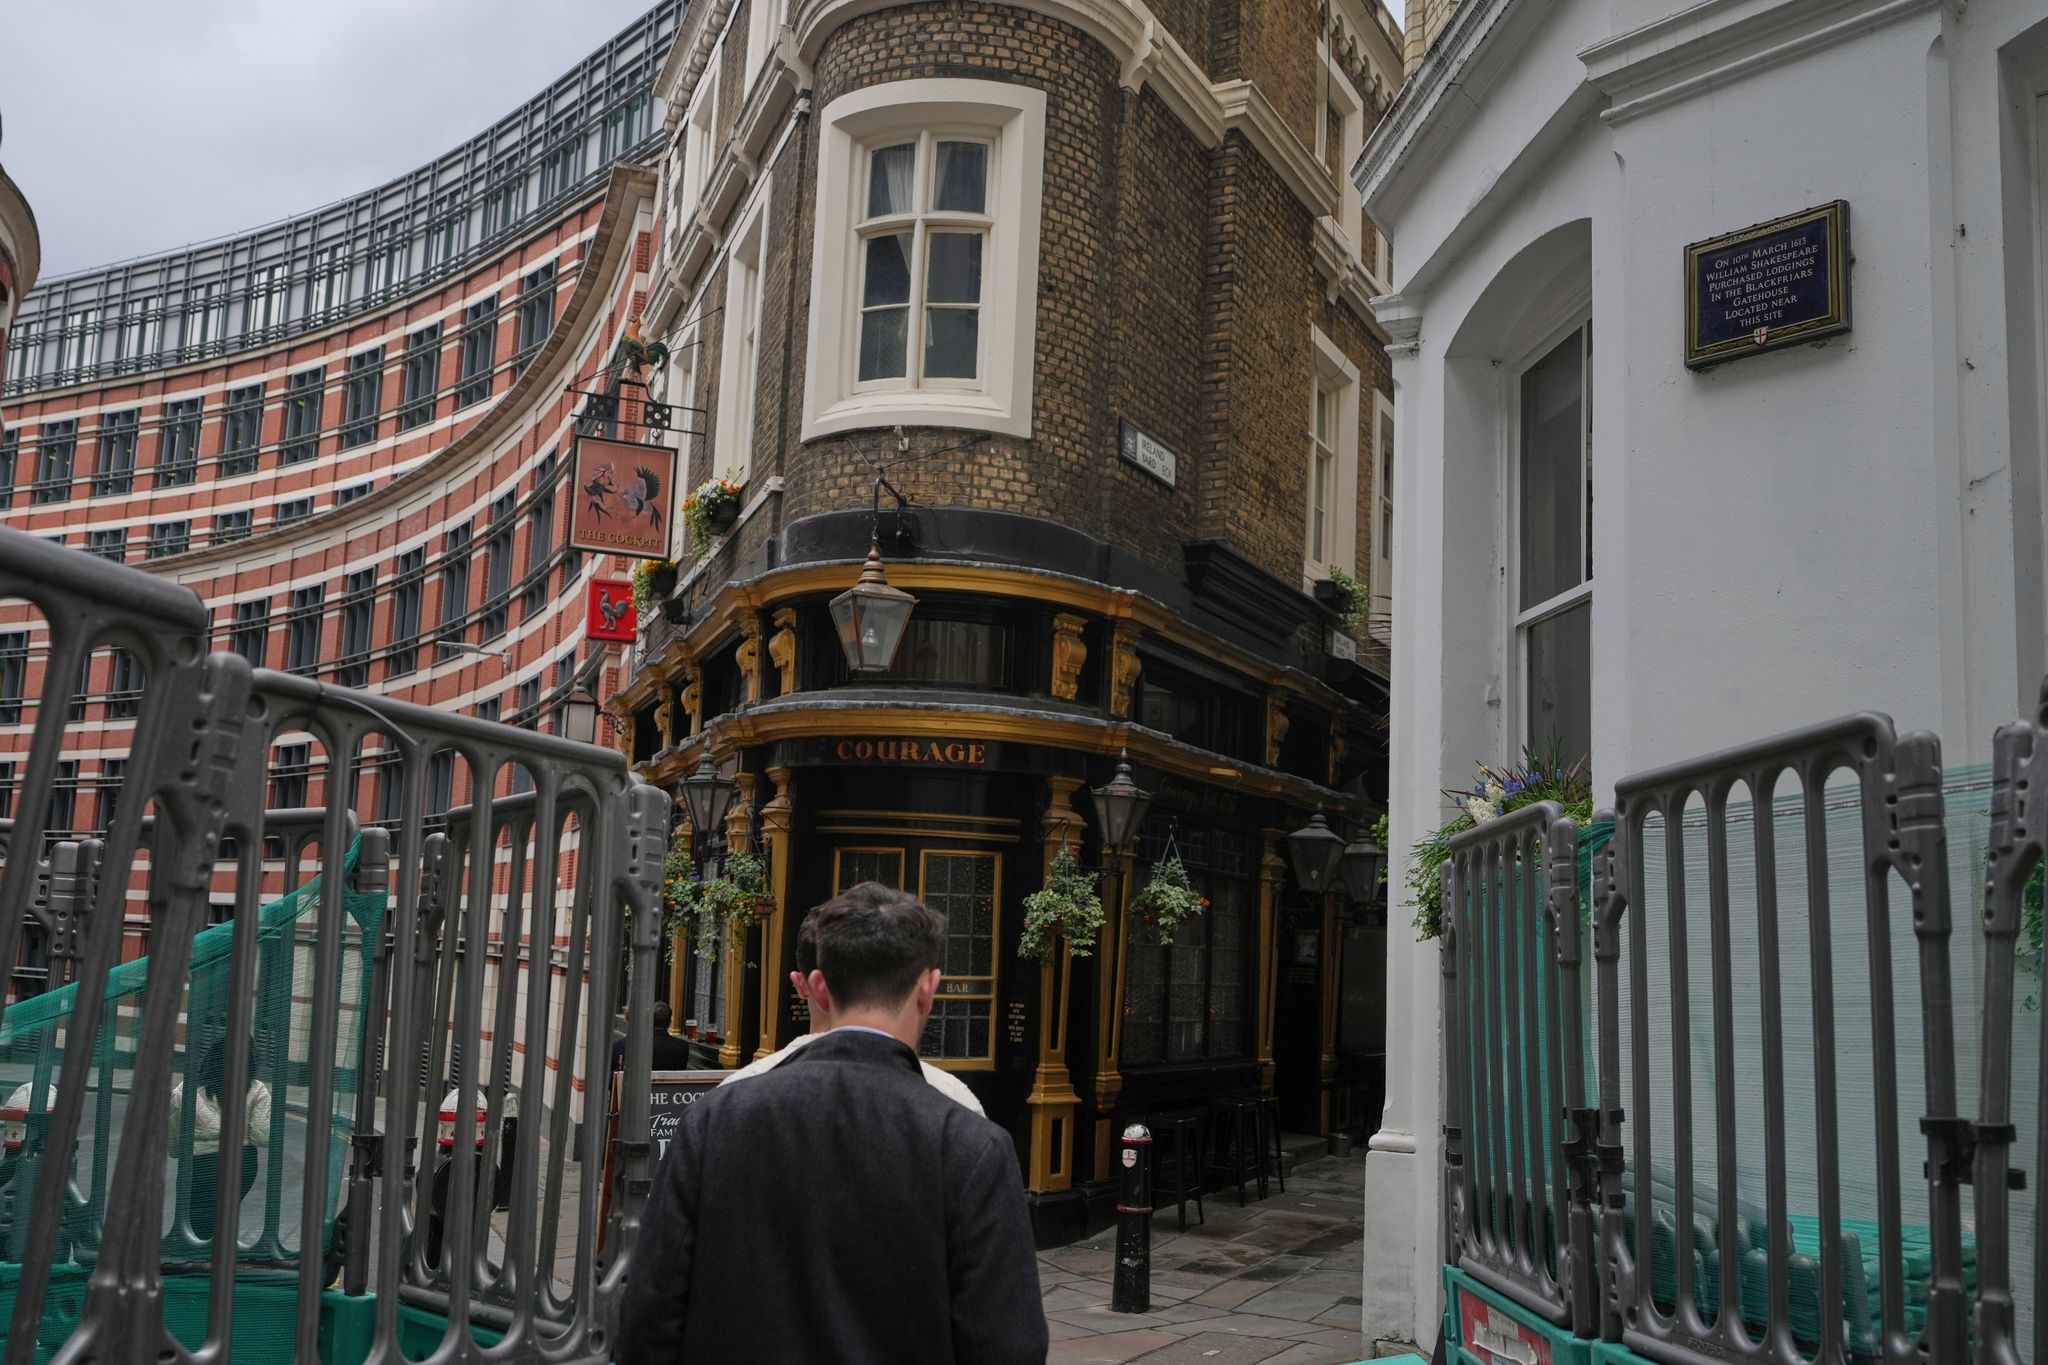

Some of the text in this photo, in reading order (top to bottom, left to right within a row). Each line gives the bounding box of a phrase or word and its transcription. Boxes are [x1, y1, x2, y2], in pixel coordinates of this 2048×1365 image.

[1706, 245, 1818, 282] WILLIAM SHAKESPEARE
[1715, 259, 1730, 269] ON
[1752, 242, 1787, 259] MARCH
[1791, 236, 1807, 248] 1613
[1709, 257, 1815, 292] PURCHASED LODGINGS
[1711, 268, 1813, 303] IN THE BLACKFRIARS
[1725, 295, 1797, 320] LOCATED NEAR
[1733, 286, 1789, 306] GATEHOUSE
[1740, 310, 1783, 327] THIS SITE
[1141, 438, 1166, 462] IRELAND
[1142, 451, 1157, 470] YARD
[579, 530, 661, 548] THE COCKPIT
[836, 741, 985, 764] COURAGE
[946, 983, 969, 993] BAR
[673, 1092, 705, 1105] COC
